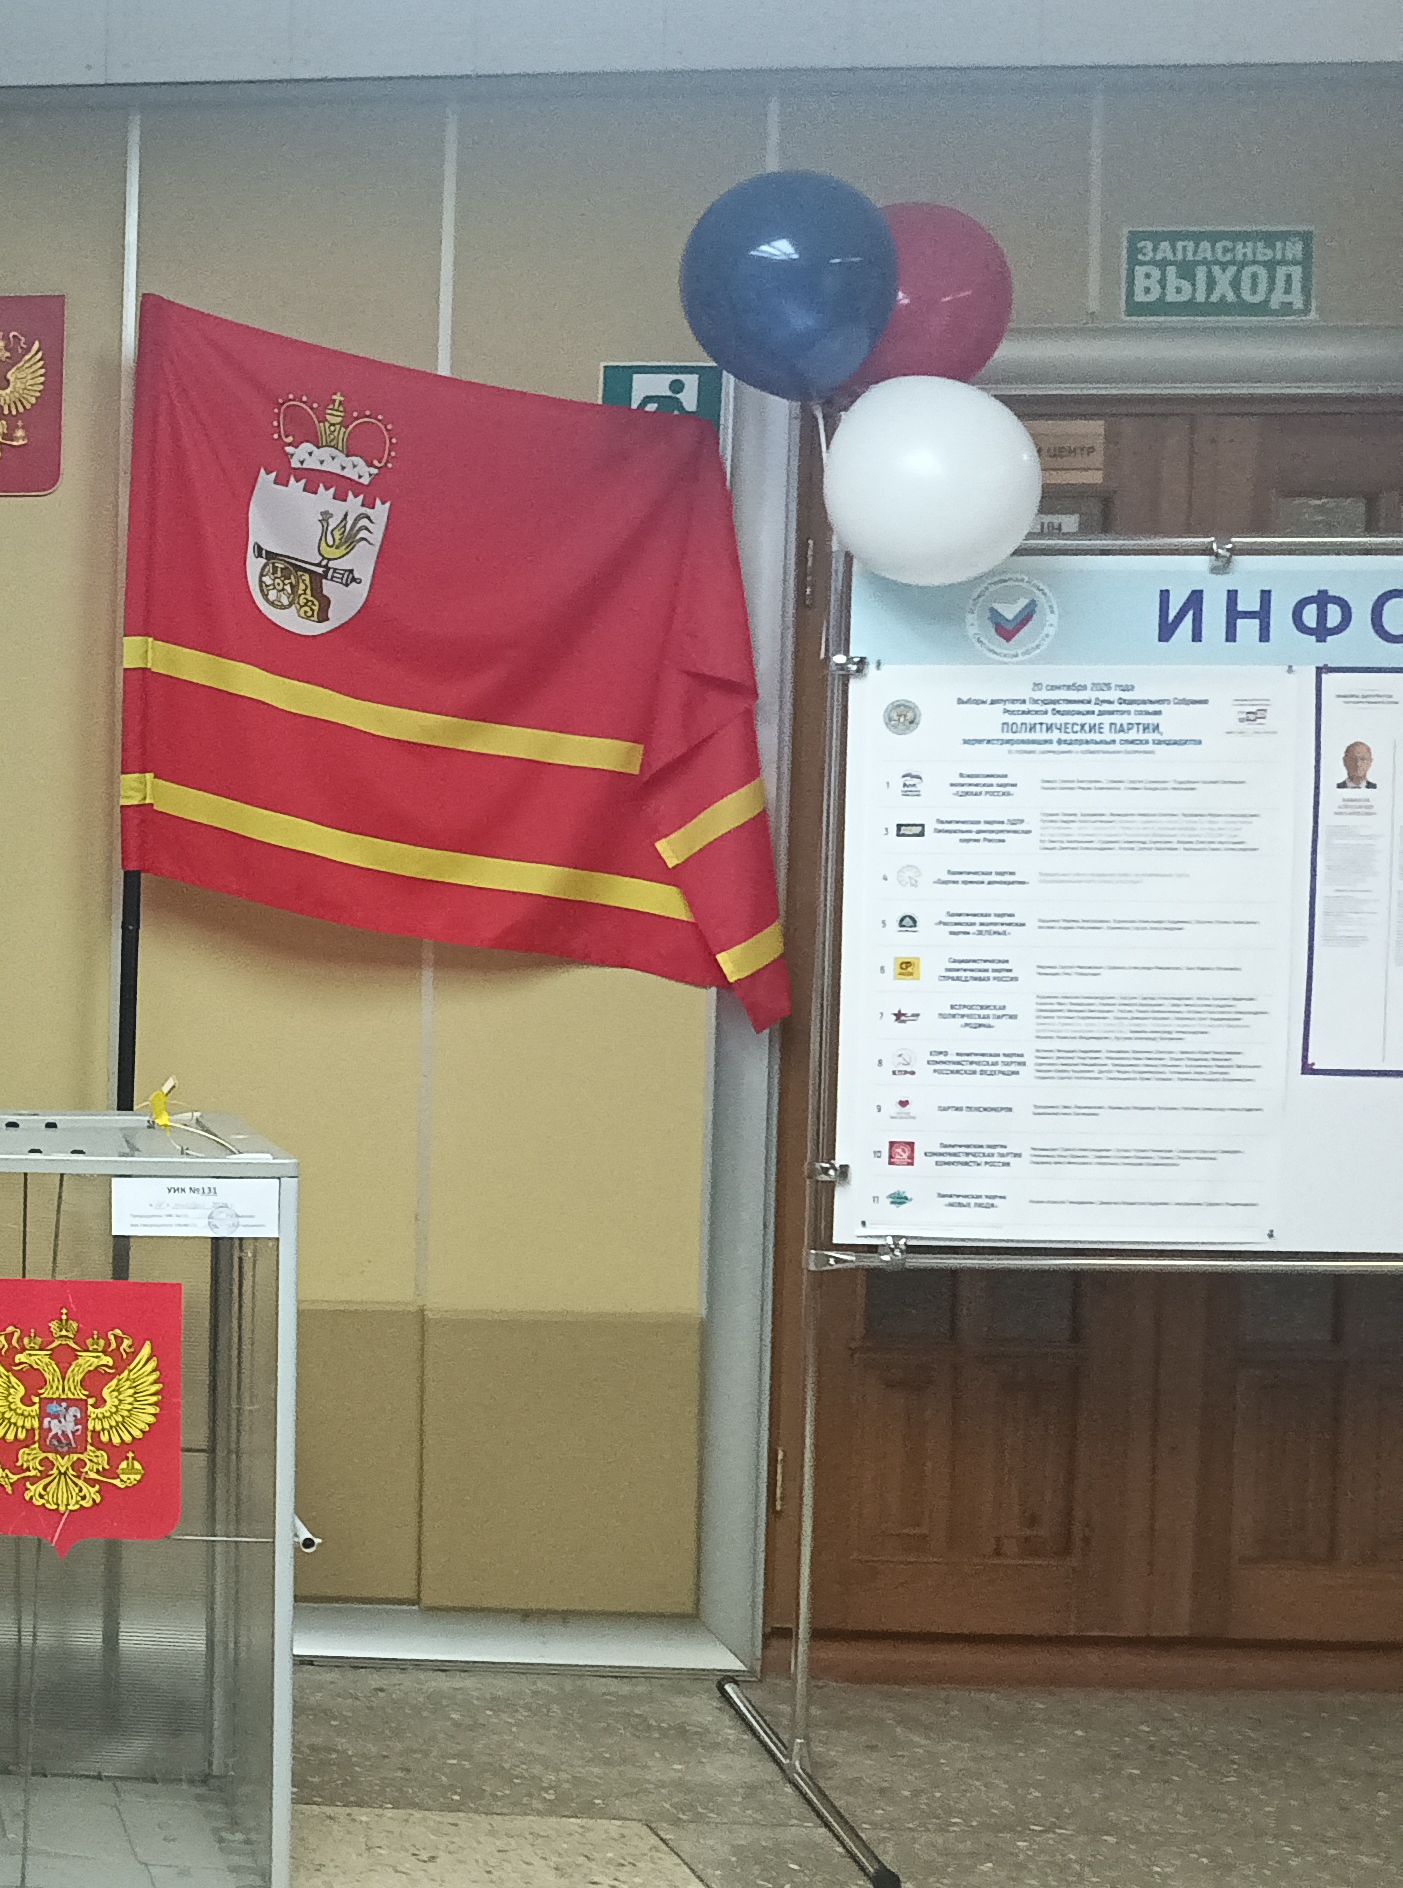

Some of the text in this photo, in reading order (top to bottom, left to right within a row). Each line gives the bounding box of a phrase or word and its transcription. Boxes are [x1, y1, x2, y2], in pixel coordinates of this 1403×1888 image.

[1137, 237, 1303, 262] ЗАПАСНЫЙ
[1134, 265, 1304, 309] ВЫХОД
[1001, 722, 1163, 736] ПОЛИТИЧЕСКИЕ ПАРТИИ,
[189, 1186, 217, 1196] №131
